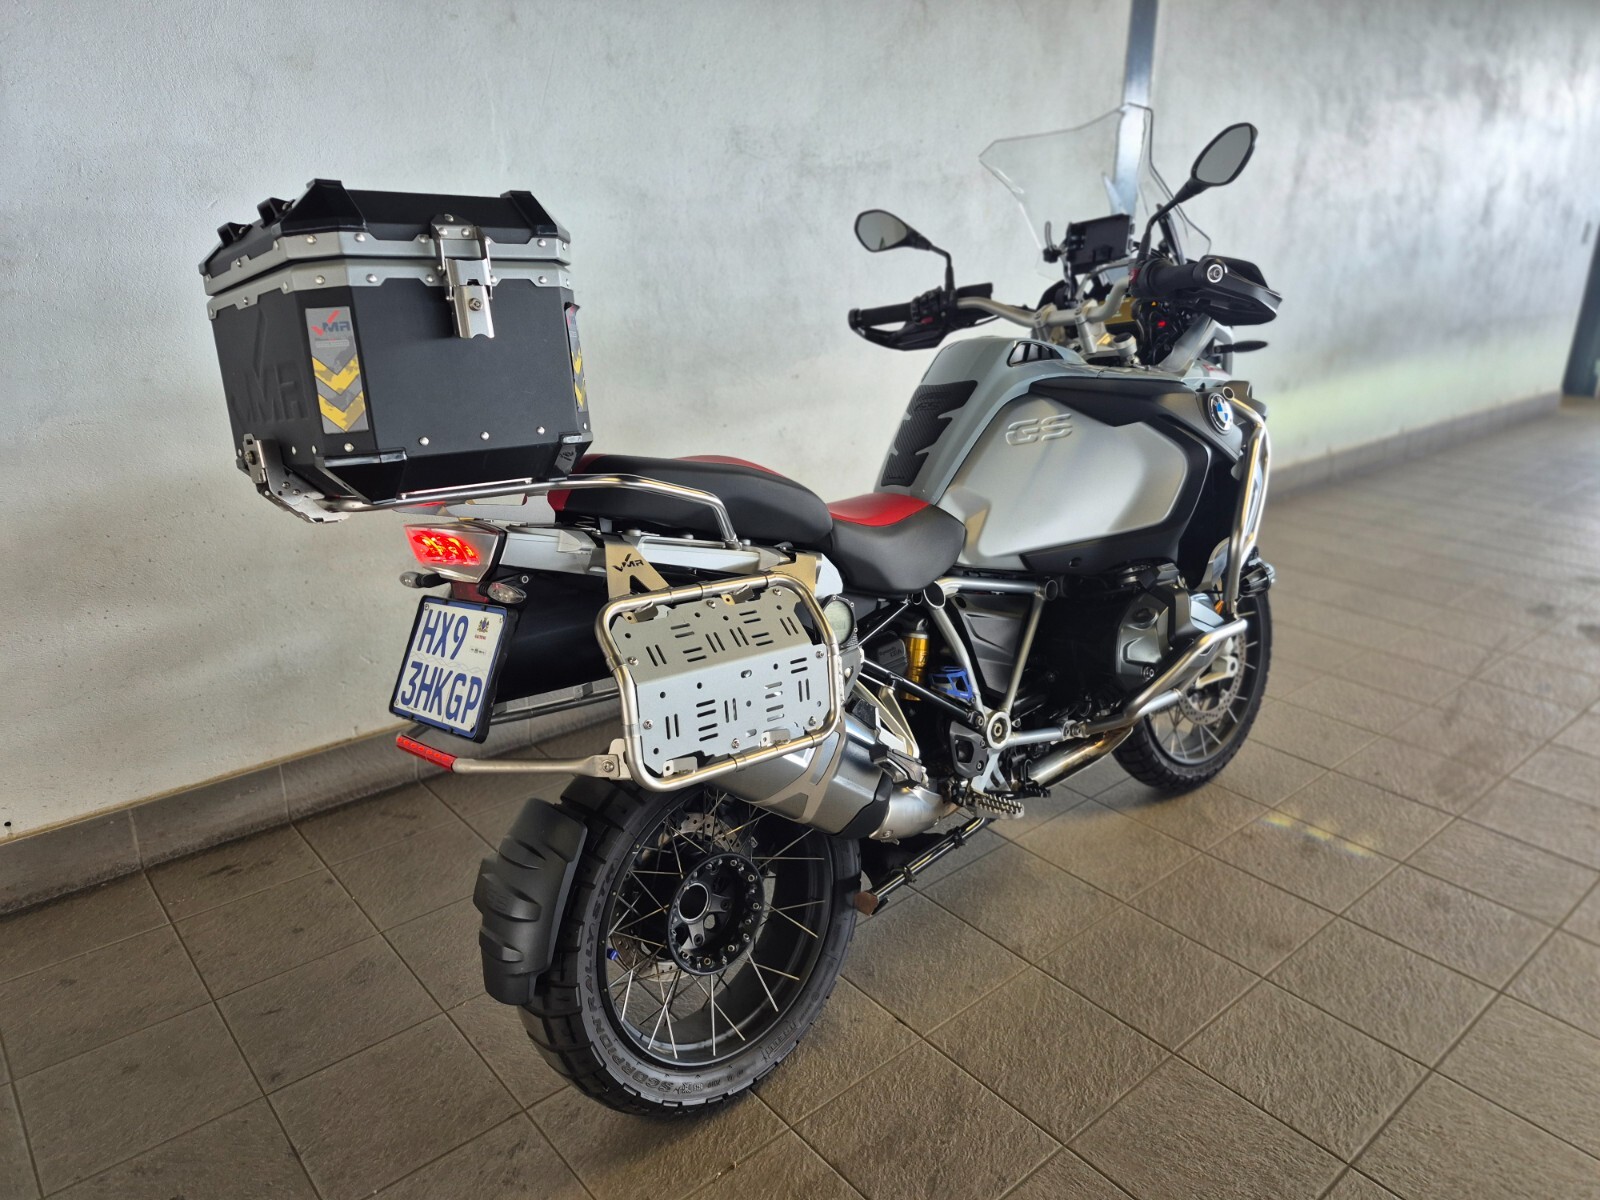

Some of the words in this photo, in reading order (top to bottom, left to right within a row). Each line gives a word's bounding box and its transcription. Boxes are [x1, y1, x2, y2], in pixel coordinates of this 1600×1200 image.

[1005, 413, 1073, 446] GS
[417, 609, 469, 660] HX9
[400, 660, 483, 724] 3HKGP
[585, 922, 597, 1013] RALLY
[591, 1015, 674, 1093] SCORPION
